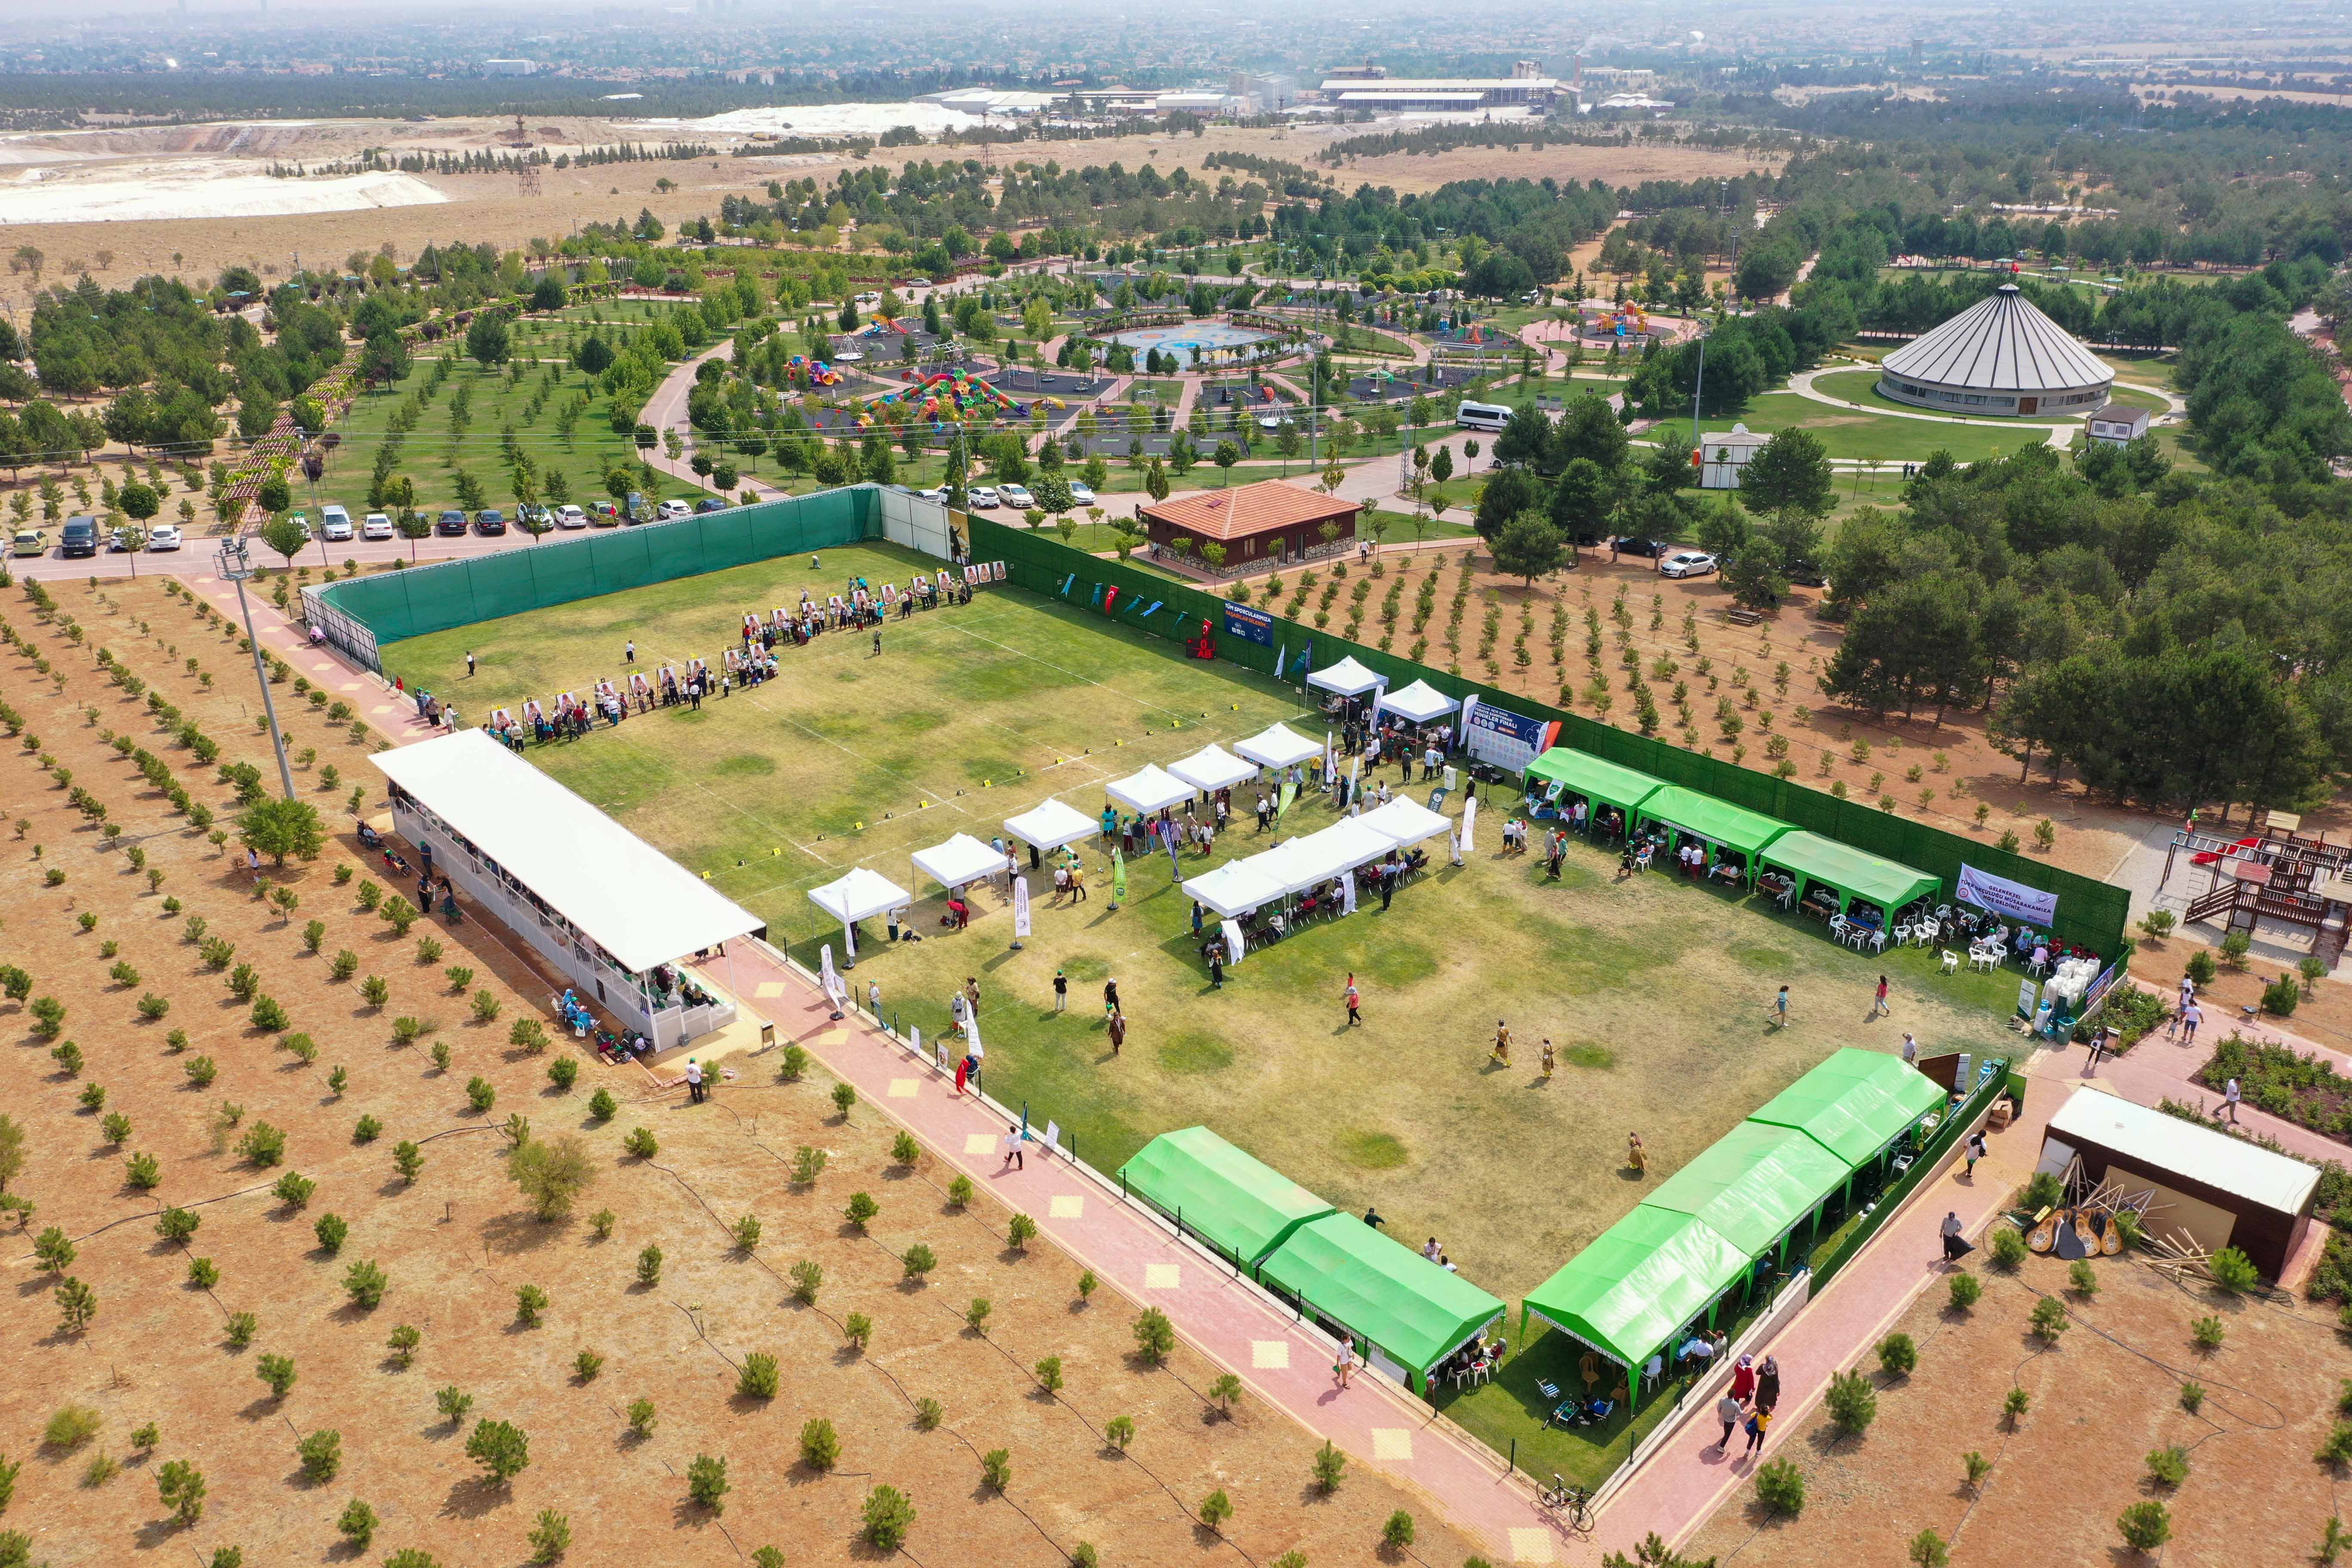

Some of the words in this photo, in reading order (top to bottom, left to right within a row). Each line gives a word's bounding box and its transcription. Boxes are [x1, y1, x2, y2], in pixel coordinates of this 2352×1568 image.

[1225, 603, 1234, 611] TÜM
[1234, 606, 1271, 623] SPORCULARIMIZA
[1197, 650, 1212, 659] AB
[1961, 879, 1974, 888] TÜRK
[1974, 886, 2003, 899] OKÇULUĞU
[2004, 896, 2051, 914] MÜSABAKAMIZA
[1983, 894, 1994, 903] HOŞ
[1988, 885, 2021, 900] GELENEKSEL
[1534, 1311, 1566, 1332] MERAM
